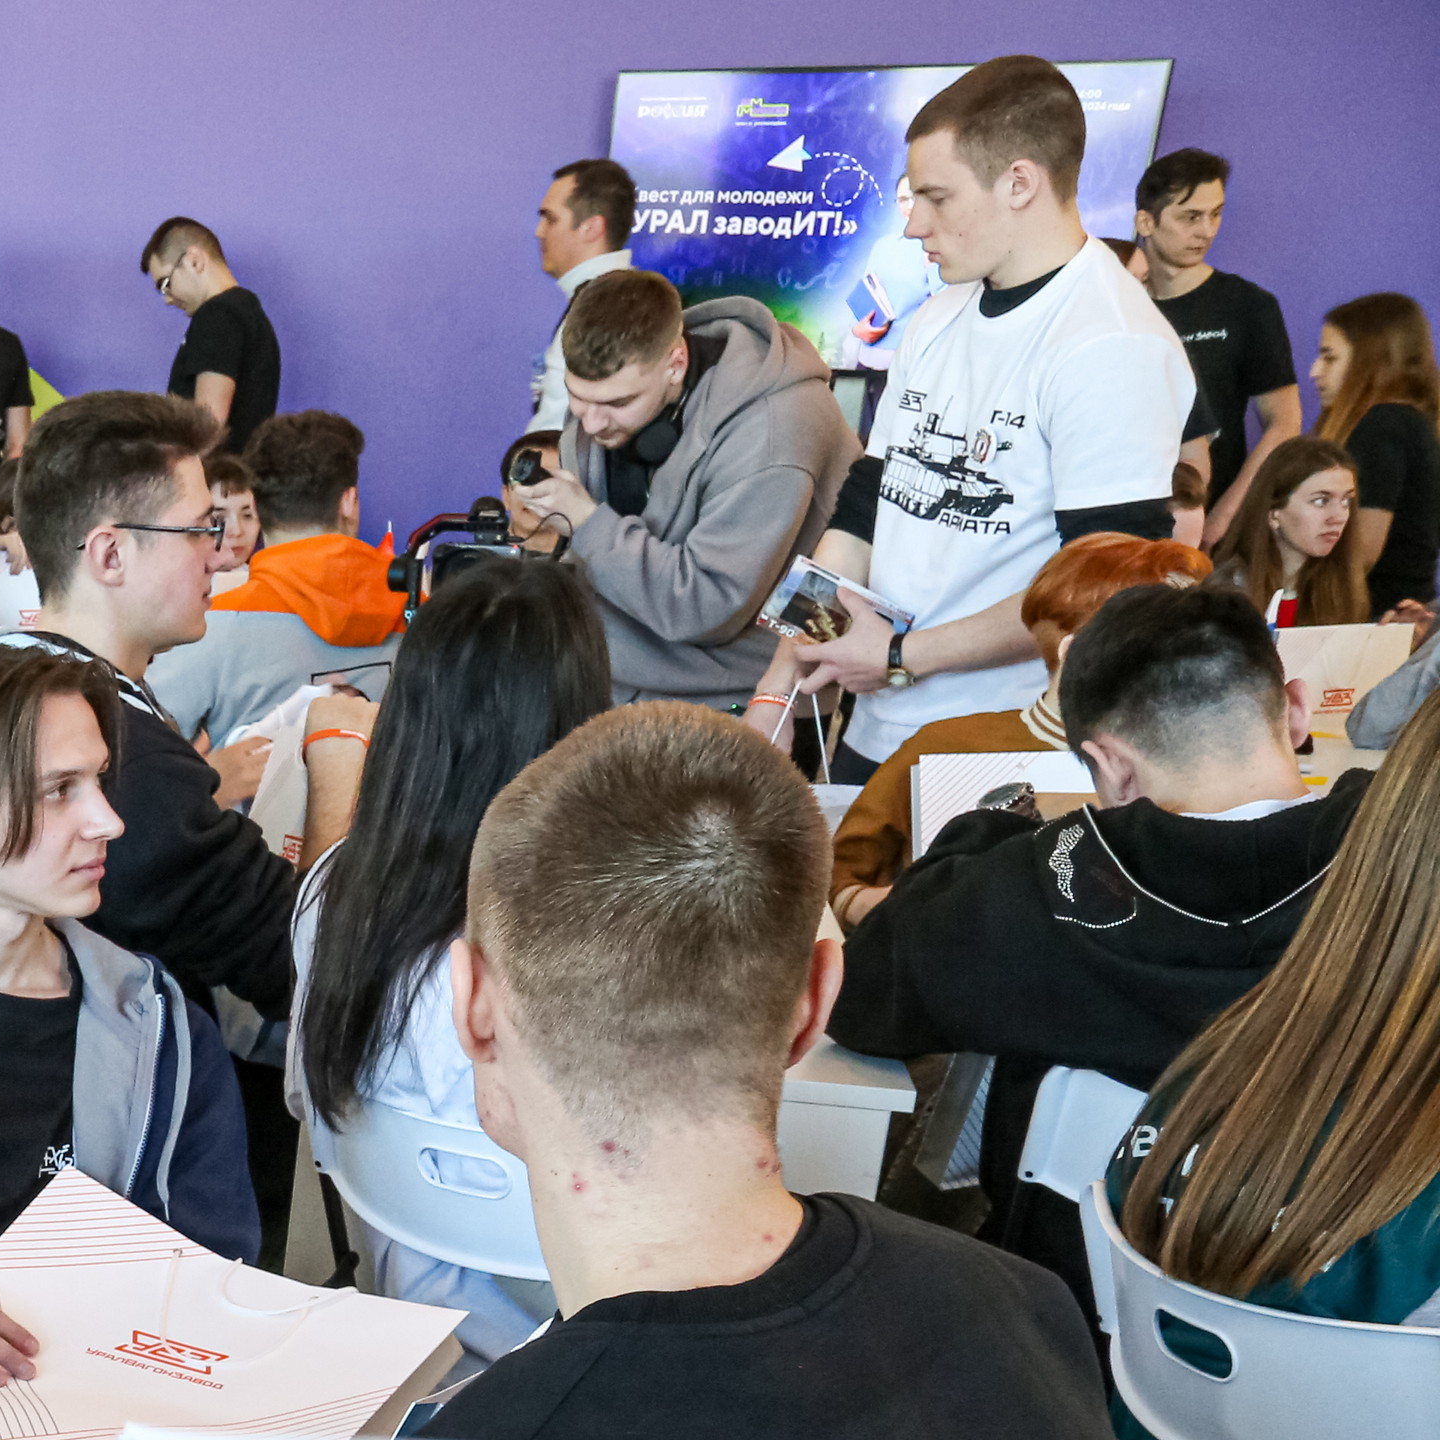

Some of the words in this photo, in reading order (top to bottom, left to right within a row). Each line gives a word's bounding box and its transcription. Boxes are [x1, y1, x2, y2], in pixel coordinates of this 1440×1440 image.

[634, 187, 678, 203] вест
[681, 190, 715, 206] для
[717, 190, 813, 206] молодежи
[713, 210, 858, 240] заводИТ!»
